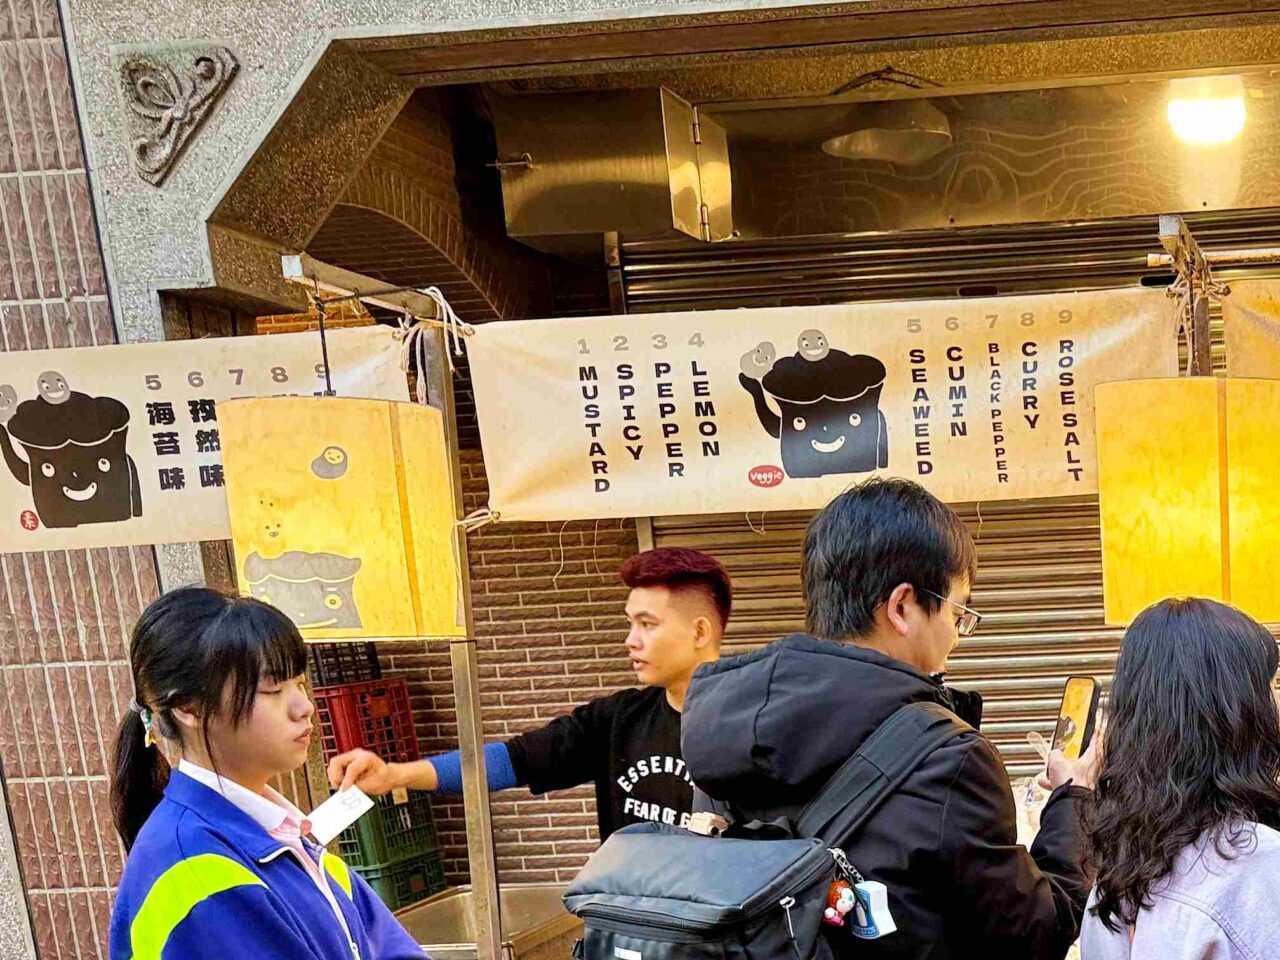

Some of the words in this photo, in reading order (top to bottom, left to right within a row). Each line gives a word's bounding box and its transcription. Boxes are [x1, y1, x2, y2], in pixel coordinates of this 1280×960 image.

[578, 338, 591, 354] 1
[612, 335, 630, 351] 2
[652, 334, 668, 350] 3
[688, 332, 705, 348] 4
[906, 318, 922, 334] 5
[945, 316, 960, 331] 6
[985, 314, 999, 329] 7
[1020, 312, 1035, 327] 8
[1058, 309, 1073, 324] 9
[145, 374, 162, 391] 5
[187, 371, 204, 388] 6
[229, 368, 244, 386] 7
[270, 366, 289, 383] 8
[691, 361, 720, 457] LEMON
[946, 346, 968, 437] CUMIN
[988, 343, 1001, 404] BLACK
[1021, 341, 1040, 429] CURRY
[1058, 339, 1076, 405] ROSE
[145, 402, 185, 491] 海苔味
[579, 365, 611, 493] MUSTARD
[616, 363, 643, 461] SPICY
[654, 362, 685, 478] PEPPER
[909, 348, 934, 475] SEAWEED
[991, 409, 1009, 484] PEPPER
[1062, 413, 1084, 482] SALT
[750, 470, 783, 485] veggie
[623, 797, 660, 821] FEAR
[662, 807, 677, 825] OF
